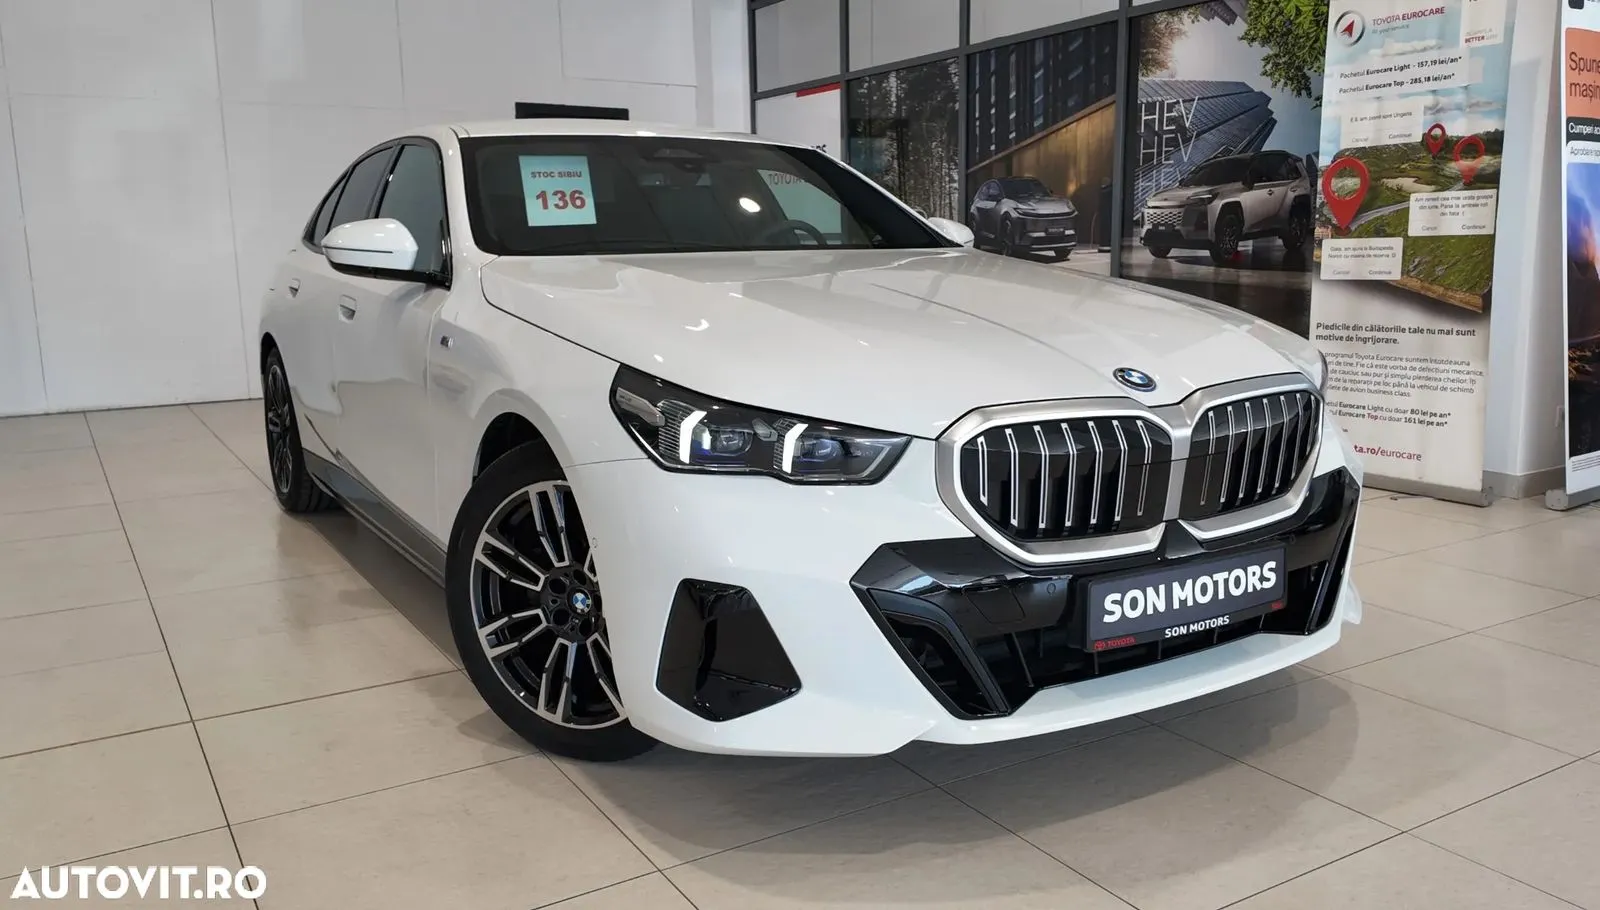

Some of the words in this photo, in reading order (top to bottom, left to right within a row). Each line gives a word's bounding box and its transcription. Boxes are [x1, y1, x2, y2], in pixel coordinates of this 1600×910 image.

[1372, 14, 1400, 26] TOYOTA
[1402, 6, 1445, 21] EUROCARE
[1340, 68, 1365, 79] Pachetul
[1366, 66, 1392, 76] Eurocare
[1394, 64, 1410, 73] Light
[1417, 60, 1438, 69] 157,19
[1339, 84, 1364, 94] Pachetul
[1365, 82, 1392, 91] Eurocare
[1410, 76, 1430, 85] 285,18
[1141, 96, 1198, 132] HEV
[1140, 131, 1197, 165] HEV
[536, 190, 586, 210] 136
[1317, 322, 1350, 331] Piedicile
[1339, 402, 1366, 410] Eurocare
[1368, 404, 1384, 413] Light
[1339, 410, 1365, 418] Eurocare
[1103, 584, 1165, 623] SON
[1172, 561, 1276, 609] MOTORS
[1165, 623, 1187, 638] SON
[1189, 615, 1230, 634] MOTORS
[1108, 636, 1136, 647] TOYOTA
